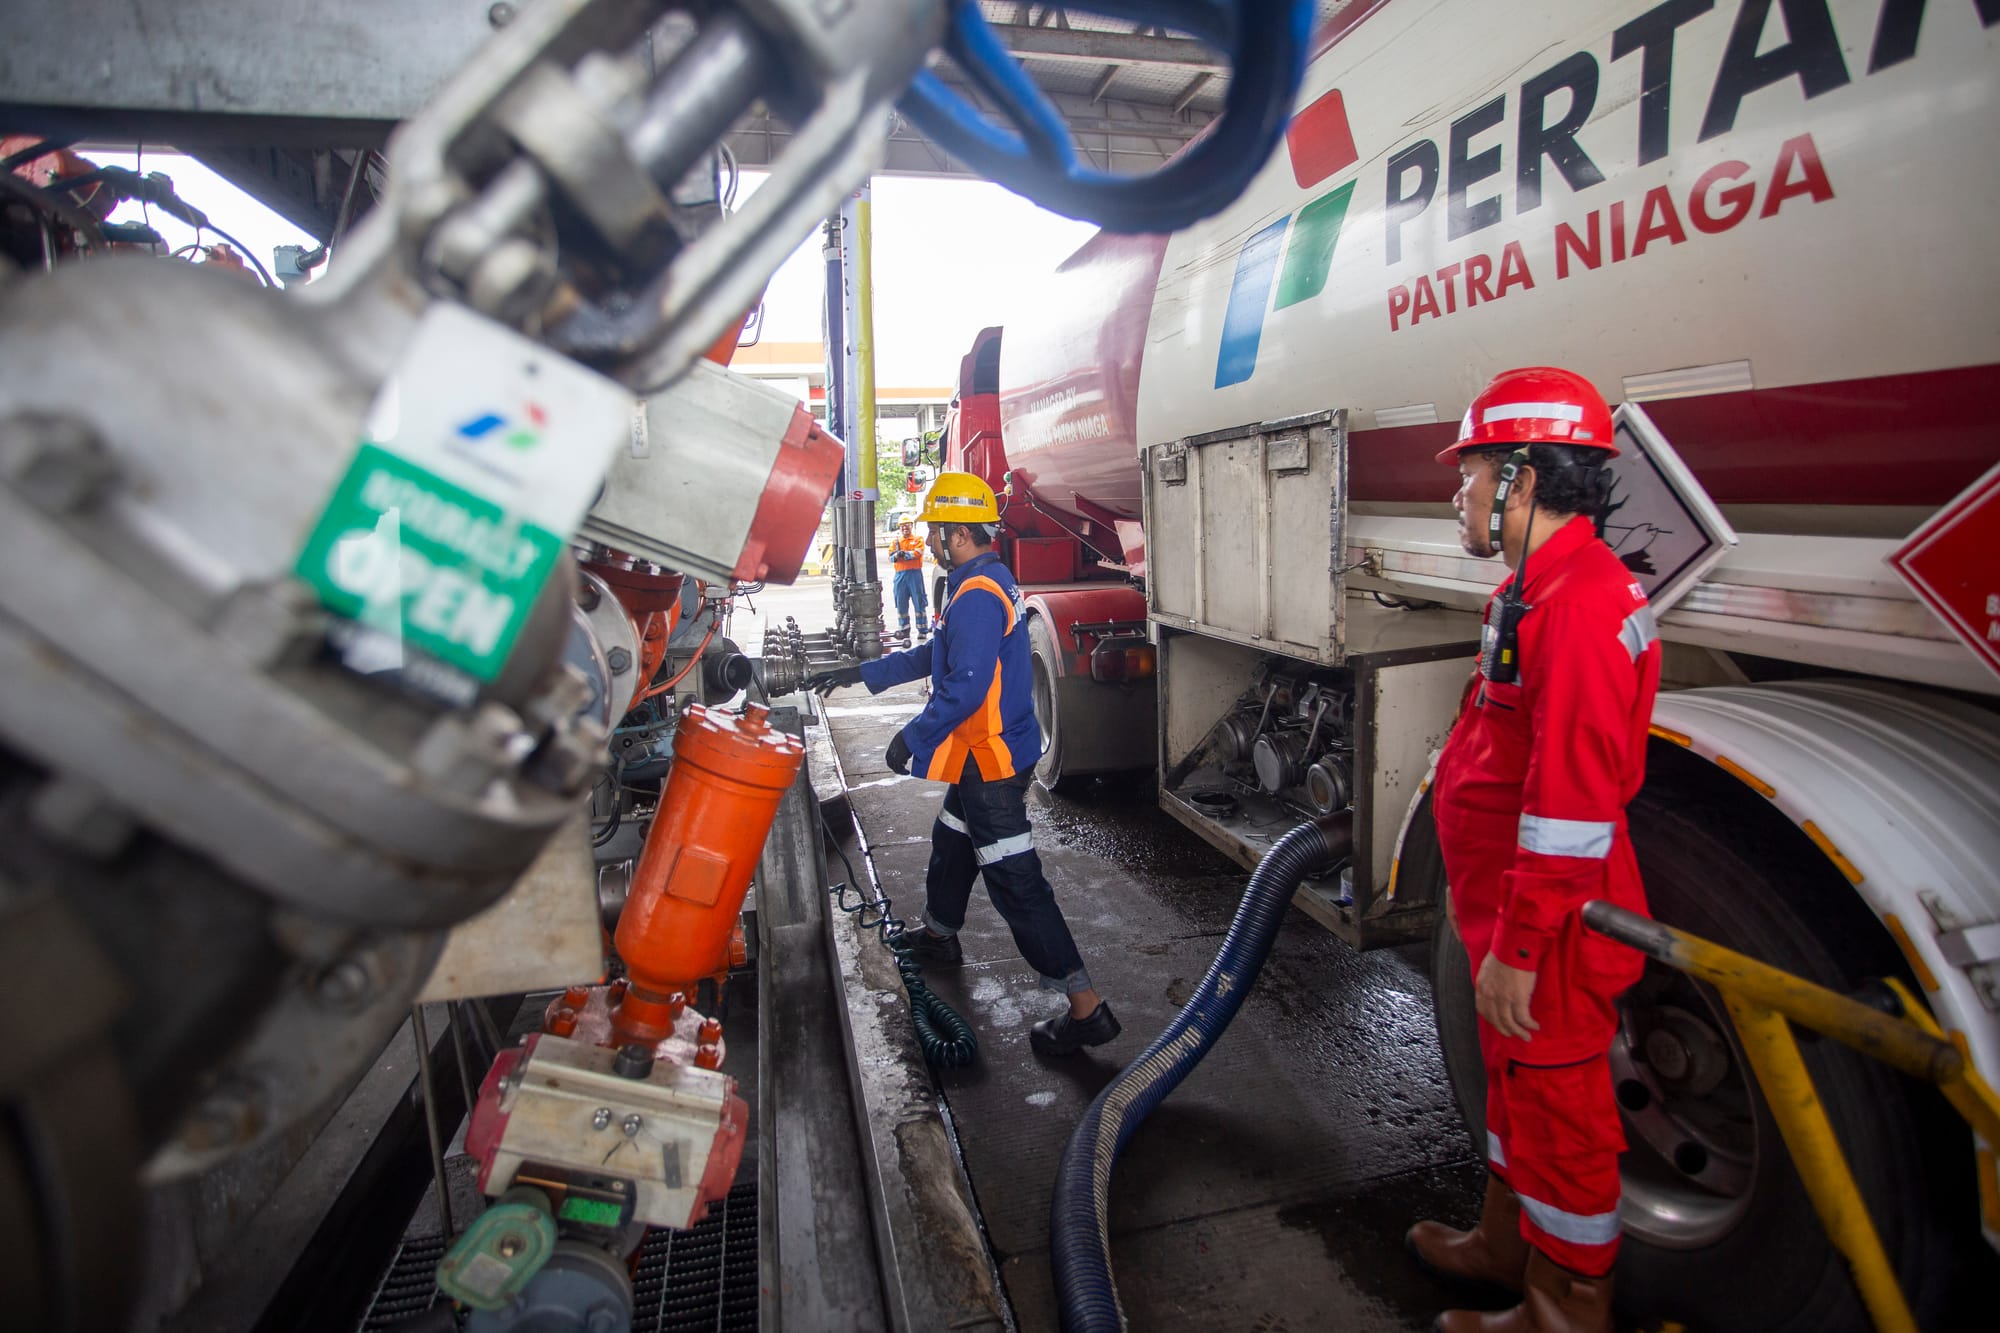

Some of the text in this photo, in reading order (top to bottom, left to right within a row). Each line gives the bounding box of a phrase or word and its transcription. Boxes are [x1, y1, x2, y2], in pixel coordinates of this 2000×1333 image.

[1388, 132, 1836, 332] PATRA NIAGA
[1078, 413, 1110, 441] NIAGA
[325, 528, 515, 657] OPEN
